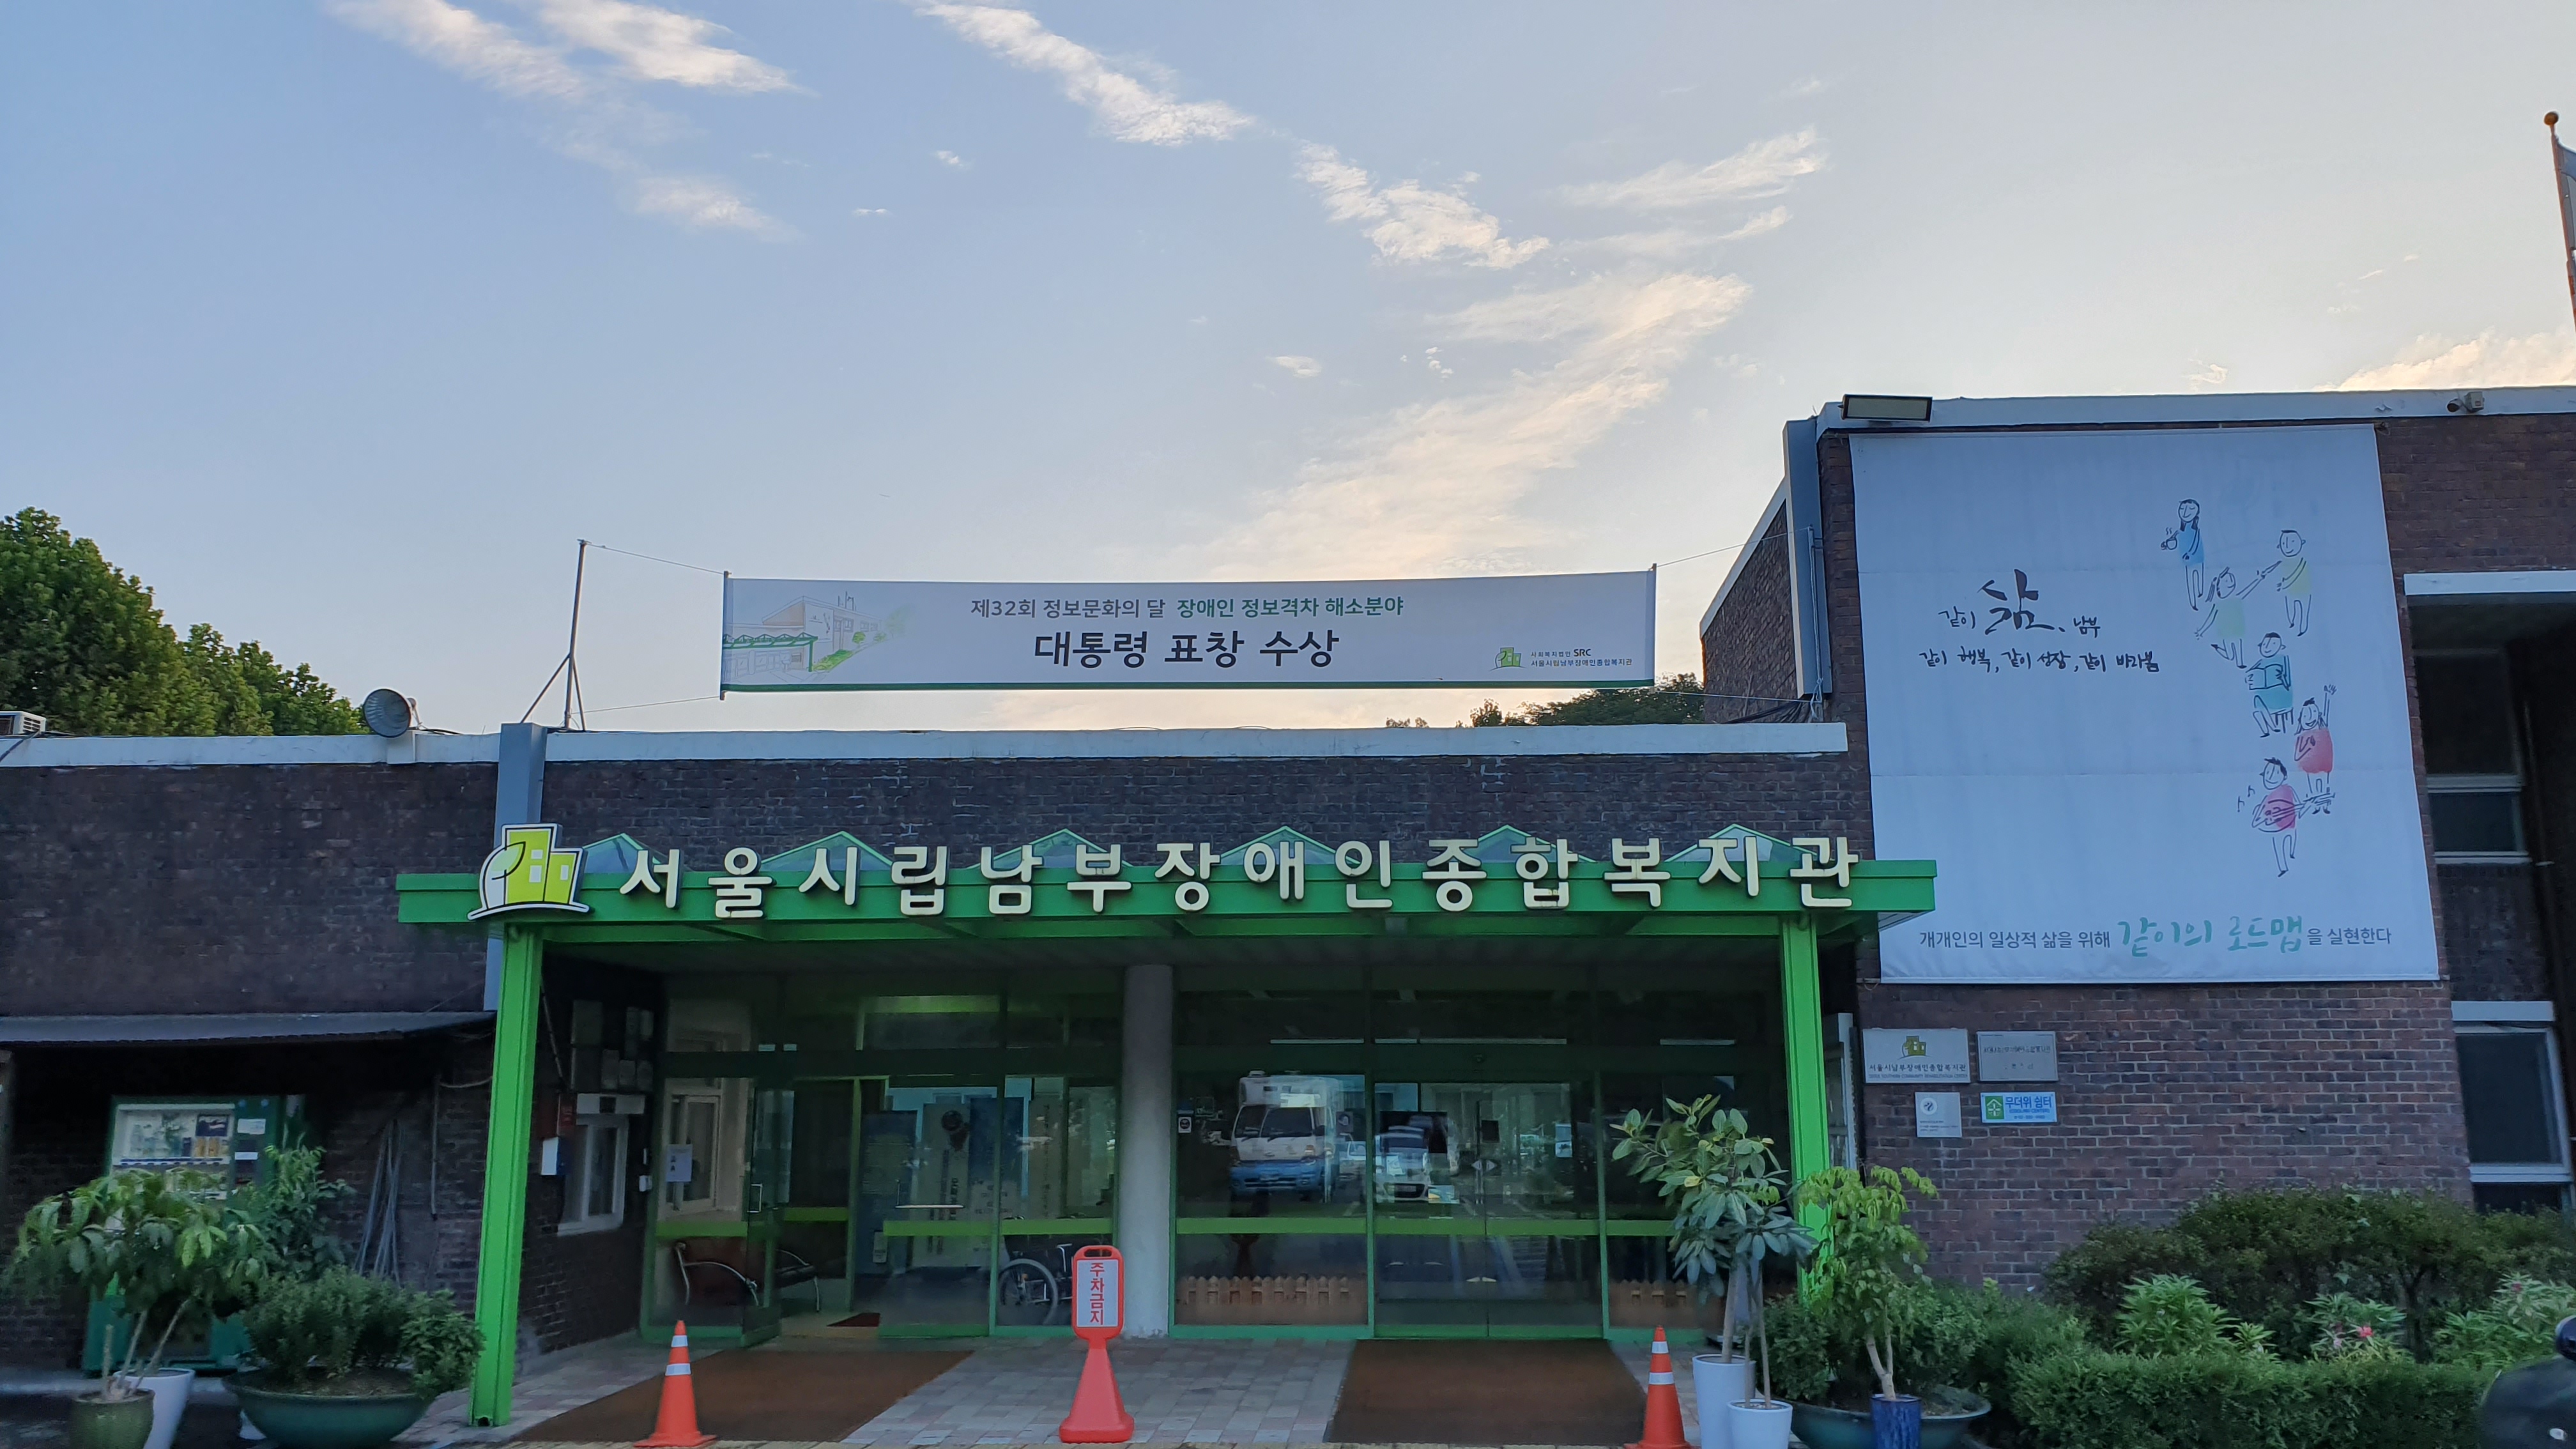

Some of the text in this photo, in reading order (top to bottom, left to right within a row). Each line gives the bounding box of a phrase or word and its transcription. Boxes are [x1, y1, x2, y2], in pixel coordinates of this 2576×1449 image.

[971, 595, 1404, 618] 제32회 정보문화의 달 장애인 정보격차 해소분야
[1938, 606, 1976, 629] 같이
[2073, 615, 2101, 638] 남부
[1035, 629, 1339, 668] 대통령 표창 수상
[1919, 648, 1947, 668] 같이
[2001, 648, 2030, 670] 같이
[2080, 653, 2106, 672] 같이
[618, 834, 1860, 920] 서울시립남부장애인종합복지관
[1920, 931, 1983, 949] 개개인의
[1989, 931, 2037, 949] 일상적
[2041, 931, 2072, 949] 삶을
[2078, 930, 2110, 948] 위해
[2327, 926, 2391, 946] 실현한다
[2005, 1096, 2051, 1108] 무더위 쉼터
[1090, 1262, 1105, 1325] 주차금지
